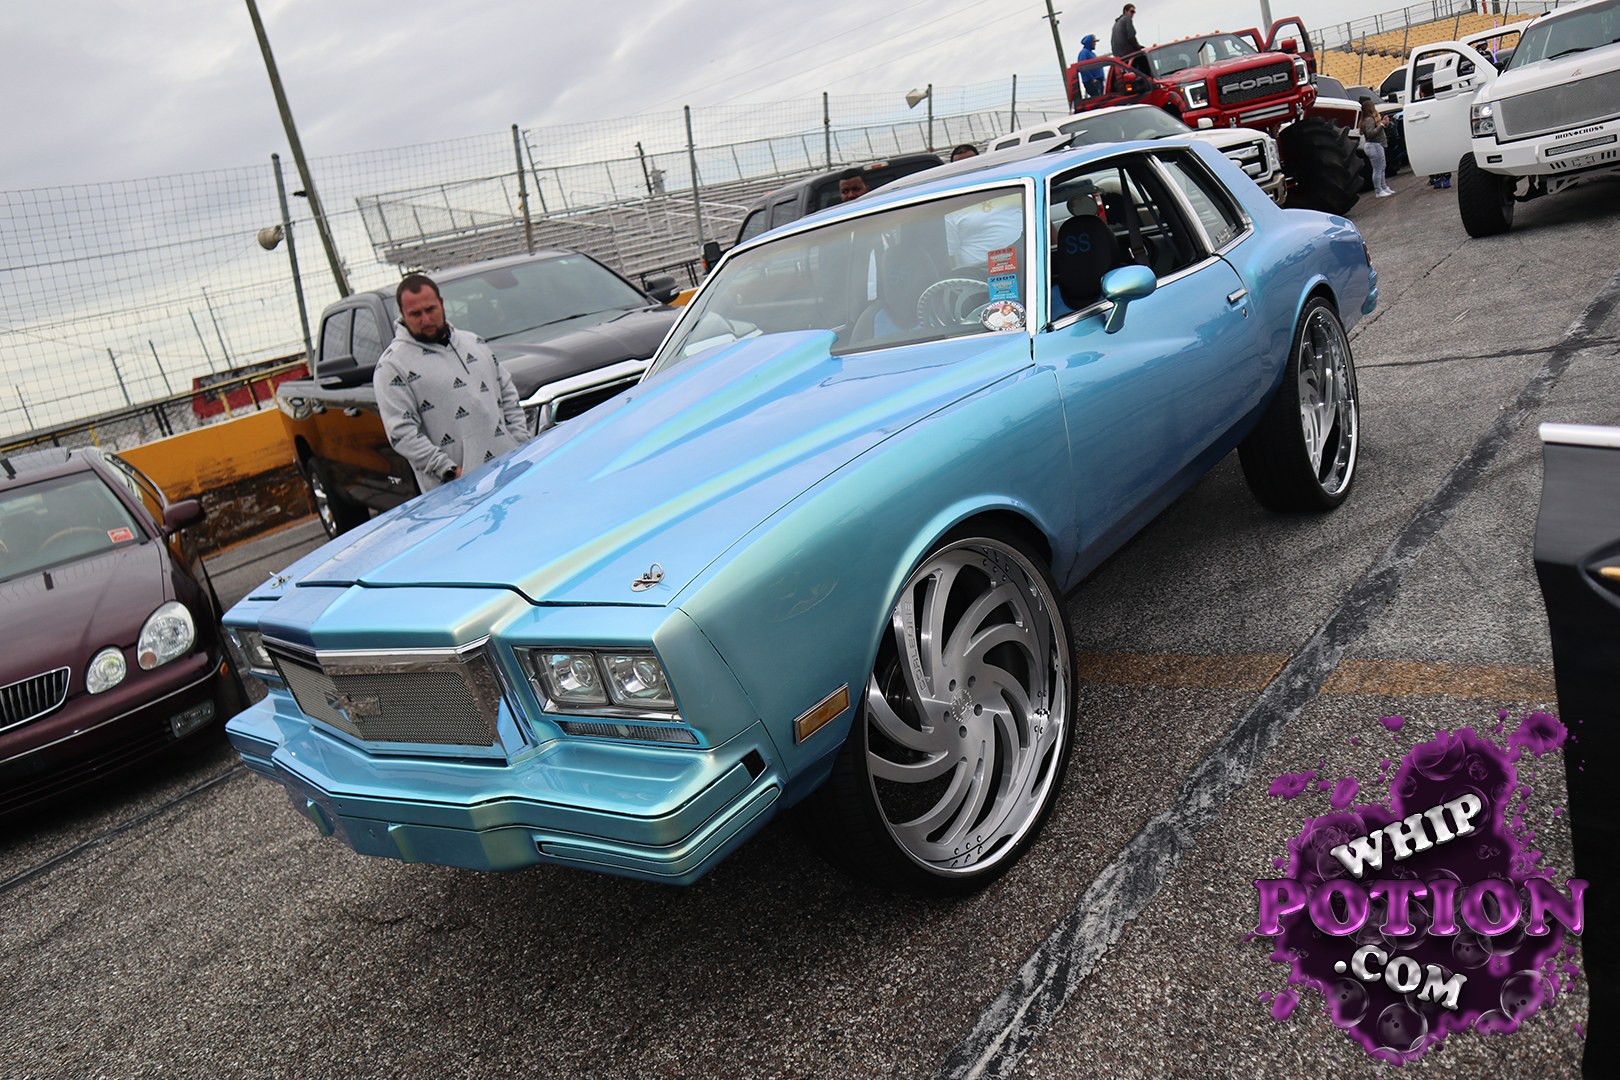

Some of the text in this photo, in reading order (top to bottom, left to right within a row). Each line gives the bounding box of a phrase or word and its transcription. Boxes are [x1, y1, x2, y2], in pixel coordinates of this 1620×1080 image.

[1222, 72, 1289, 95] FORD
[1555, 125, 1604, 140] IRON CROSS
[1066, 233, 1091, 254] SS
[904, 600, 927, 691] CORLEONE
